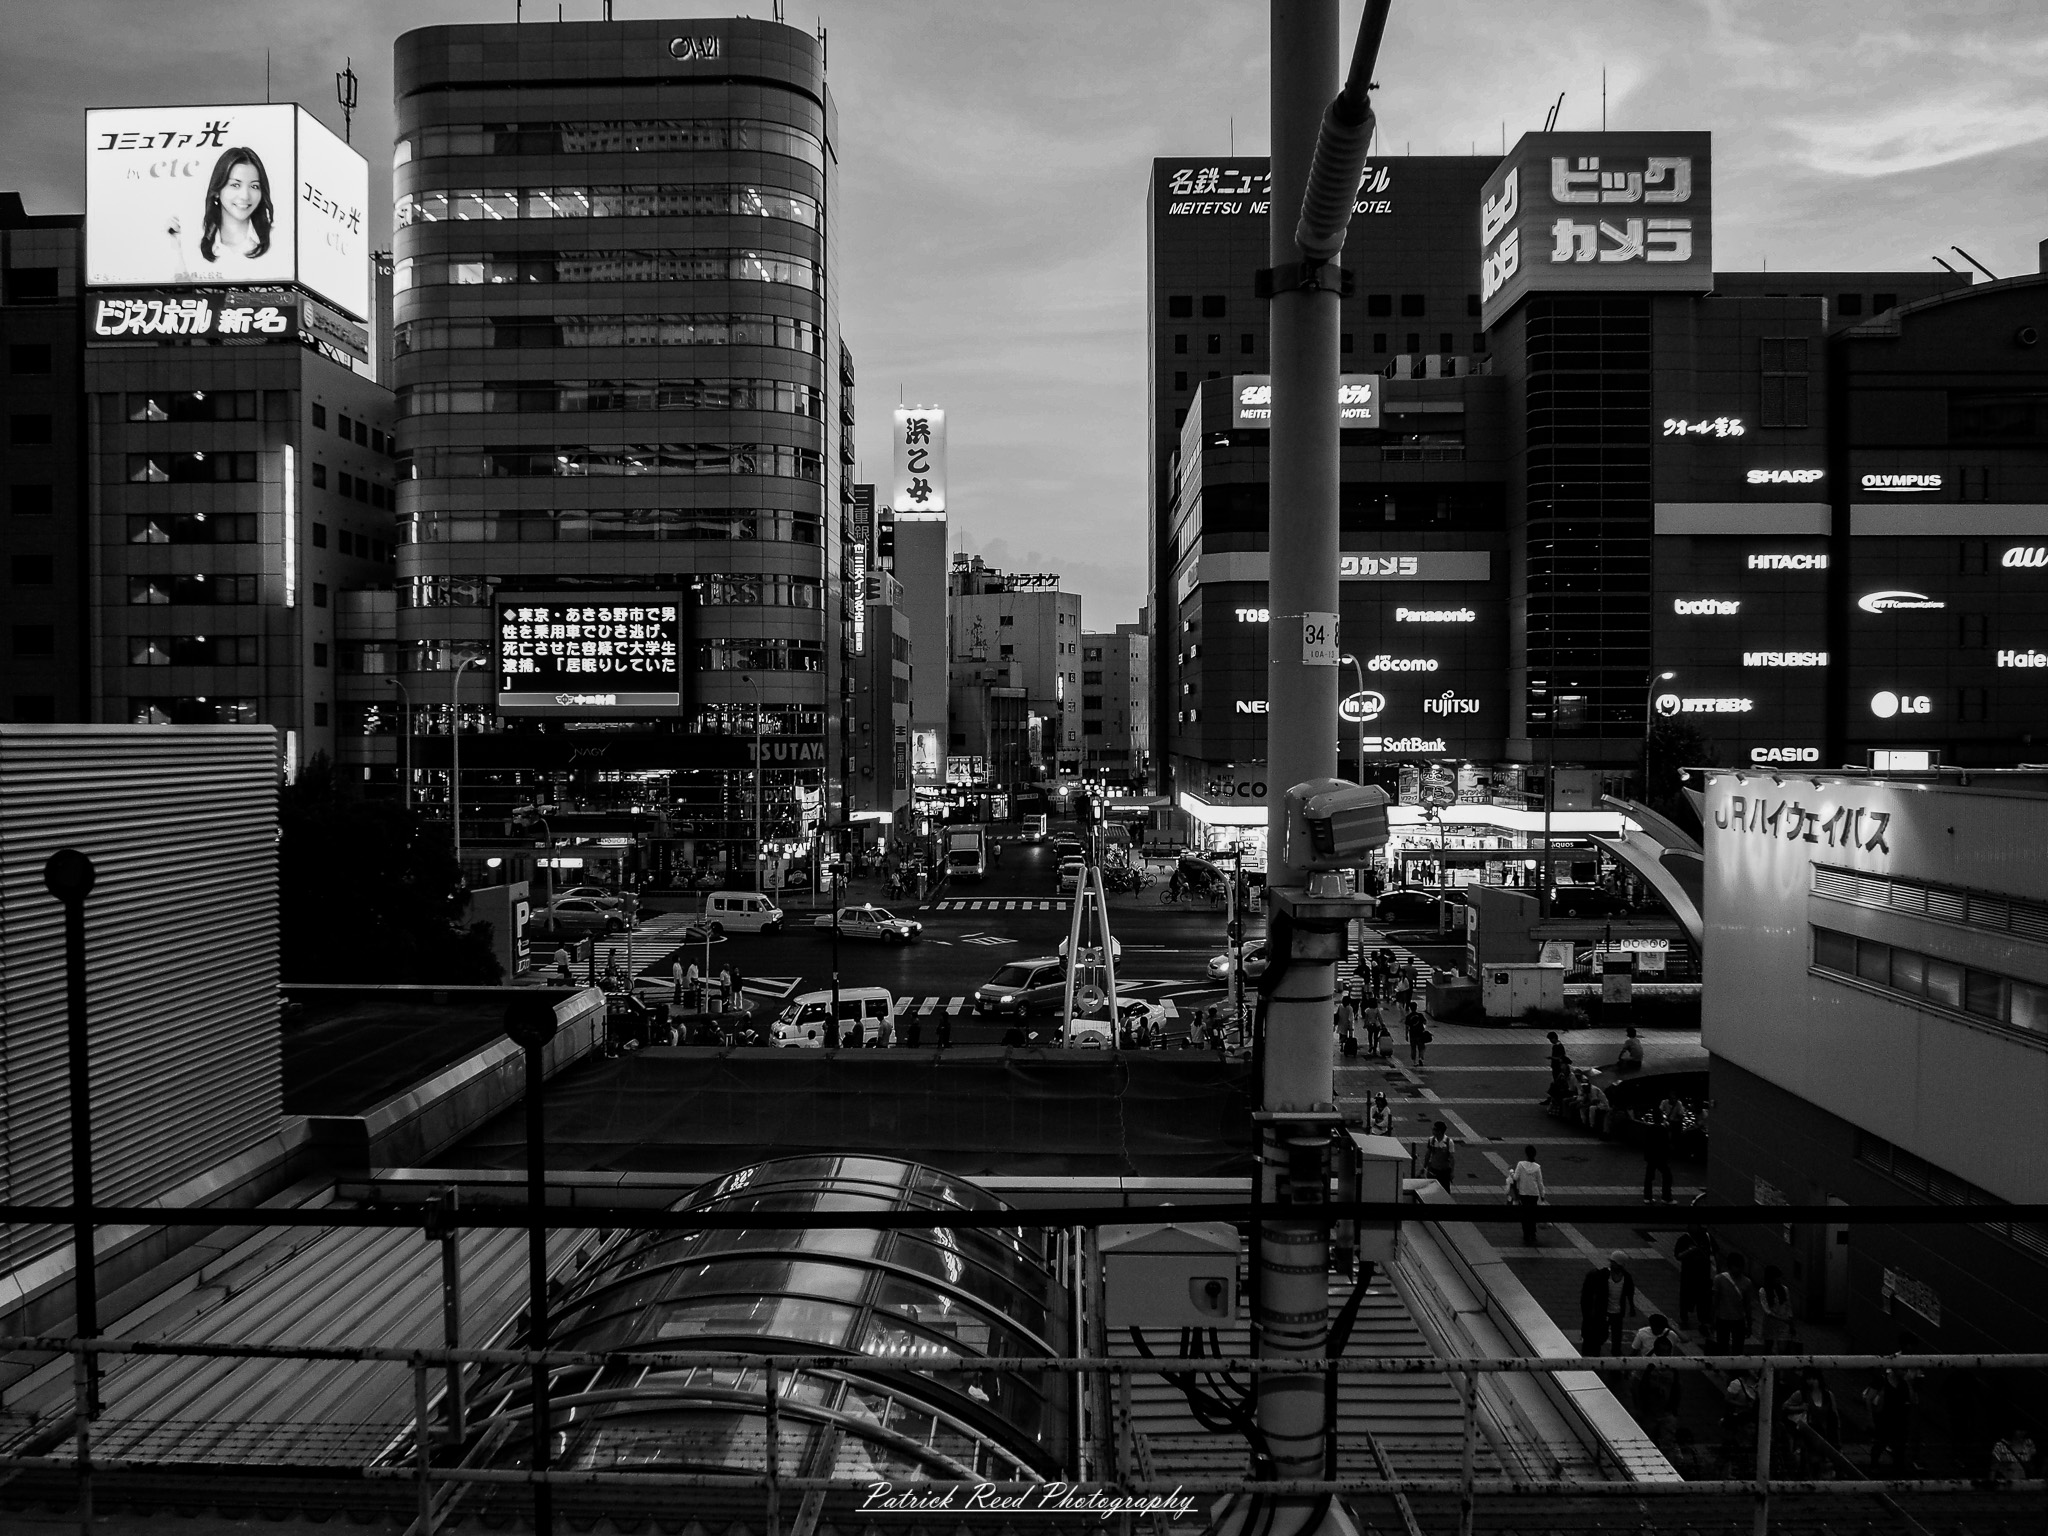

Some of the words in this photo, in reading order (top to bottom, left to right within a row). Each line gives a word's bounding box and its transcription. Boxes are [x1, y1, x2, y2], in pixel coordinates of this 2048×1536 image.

[1551, 156, 1692, 204] ビック
[1169, 202, 1242, 214] MEITETSU
[1551, 218, 1693, 262] カメラ
[96, 299, 212, 336] ビジネスホテル
[1341, 409, 1371, 418] HOTEL
[905, 417, 933, 504] 浜乙女
[1746, 469, 1824, 484] SHARP
[1862, 474, 1942, 487] OLYMPUS
[854, 489, 870, 552] 三重銀
[1748, 554, 1828, 569] HITACHI
[2002, 547, 2048, 568] au
[1396, 607, 1476, 622] Panasonic
[1674, 599, 1740, 615] brother
[1367, 655, 1439, 671] docomo
[1743, 652, 1828, 667] MITSUBISHI
[1997, 650, 2048, 668] Haie
[1344, 697, 1378, 713] inel
[1424, 698, 1480, 717] FUJITSU
[1901, 696, 1931, 713] LG
[747, 742, 826, 761] TSUTAYA
[1383, 737, 1447, 752] SoftBank
[1751, 748, 1819, 762] CASIO
